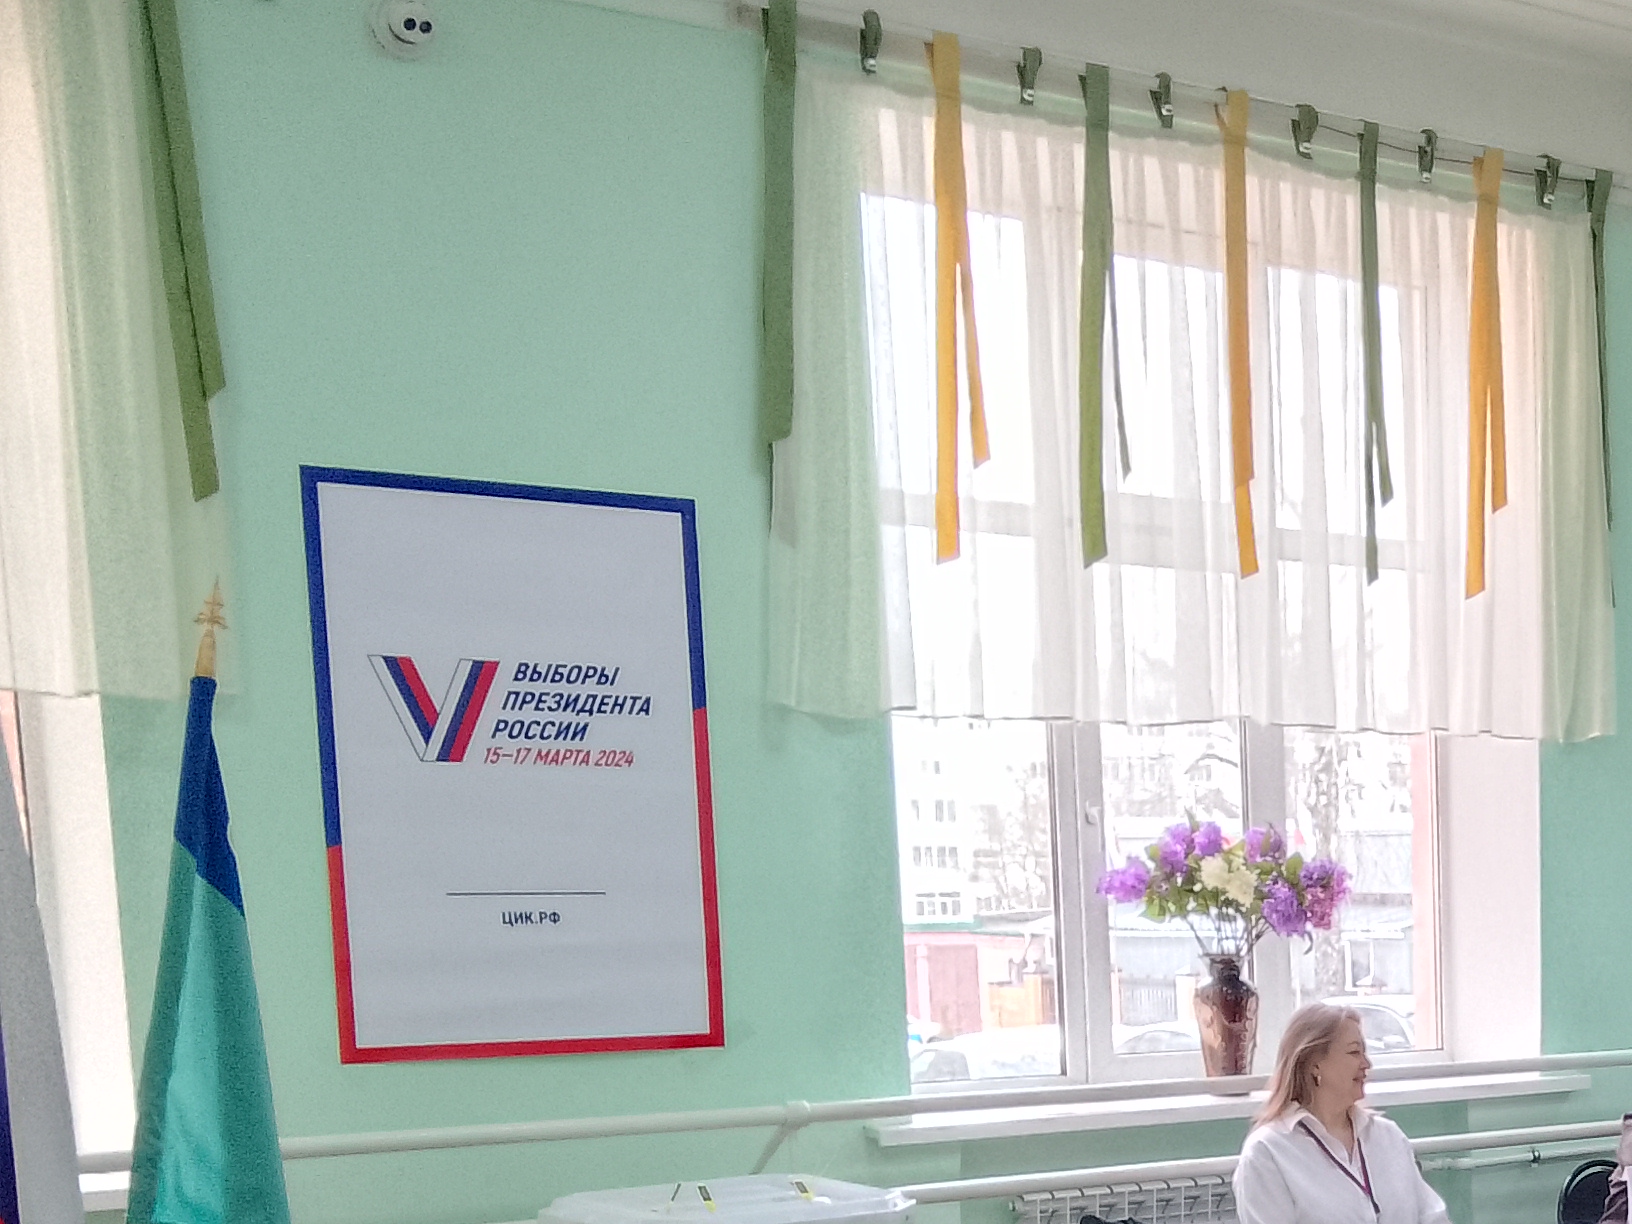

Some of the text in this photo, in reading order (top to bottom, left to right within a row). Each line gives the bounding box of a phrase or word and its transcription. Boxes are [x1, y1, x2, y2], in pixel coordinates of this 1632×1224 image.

[512, 662, 621, 686] ВЫБОРЫ
[501, 690, 651, 717] ПРЕЗИДЕНТА
[491, 719, 590, 742] РОССИИ
[533, 749, 592, 767] МАРТА
[594, 750, 635, 768] 2024
[502, 911, 561, 927] ЦИК.РФ
